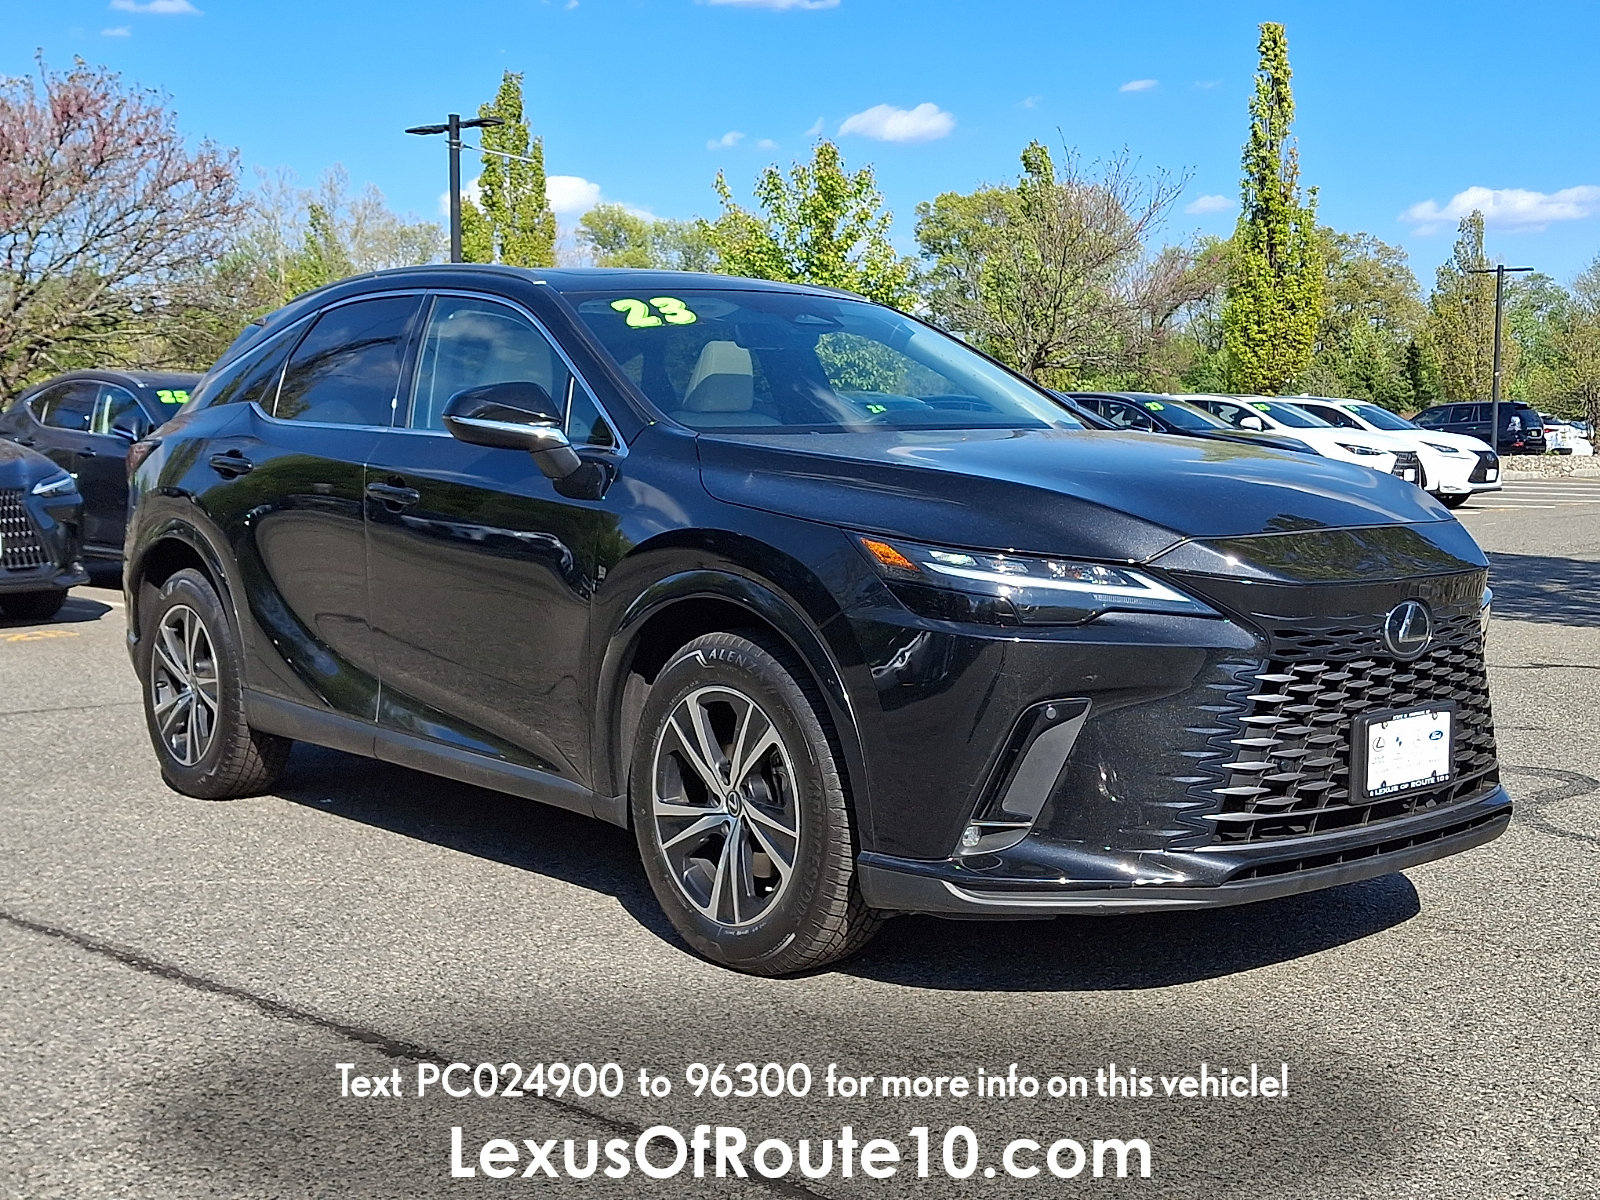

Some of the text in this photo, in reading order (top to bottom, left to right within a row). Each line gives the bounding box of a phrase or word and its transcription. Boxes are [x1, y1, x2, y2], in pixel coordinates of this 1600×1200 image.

[610, 296, 697, 329] 23
[156, 389, 190, 404] 25
[708, 648, 764, 682] ALENZ
[1374, 785, 1399, 796] LEXUS
[1410, 777, 1436, 788] ROUTE
